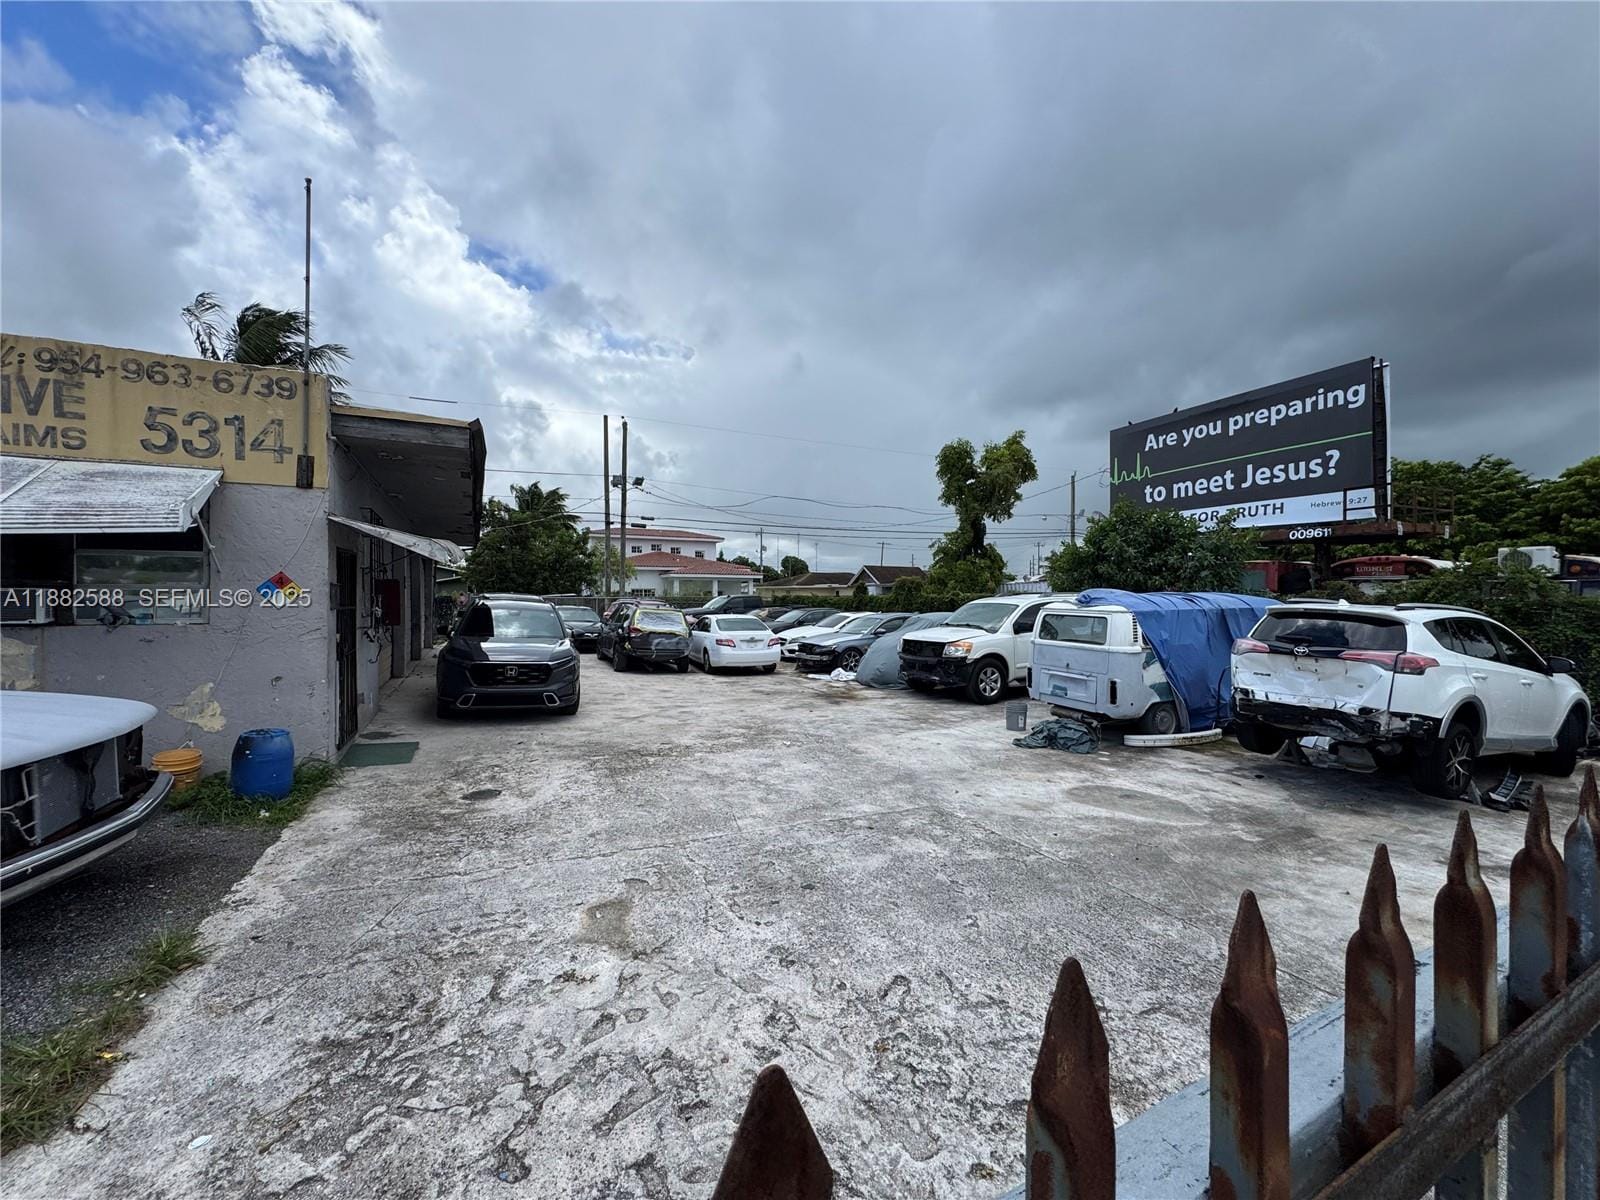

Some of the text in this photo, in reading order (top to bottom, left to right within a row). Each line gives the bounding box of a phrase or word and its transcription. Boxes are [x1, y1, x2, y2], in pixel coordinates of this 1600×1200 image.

[140, 405, 293, 464] 5314
[1145, 383, 1366, 452] Are you preparing
[1144, 449, 1340, 503] to meet Jesus?
[1310, 496, 1368, 508] Hebrew 9:27
[1226, 502, 1285, 521] RUTH
